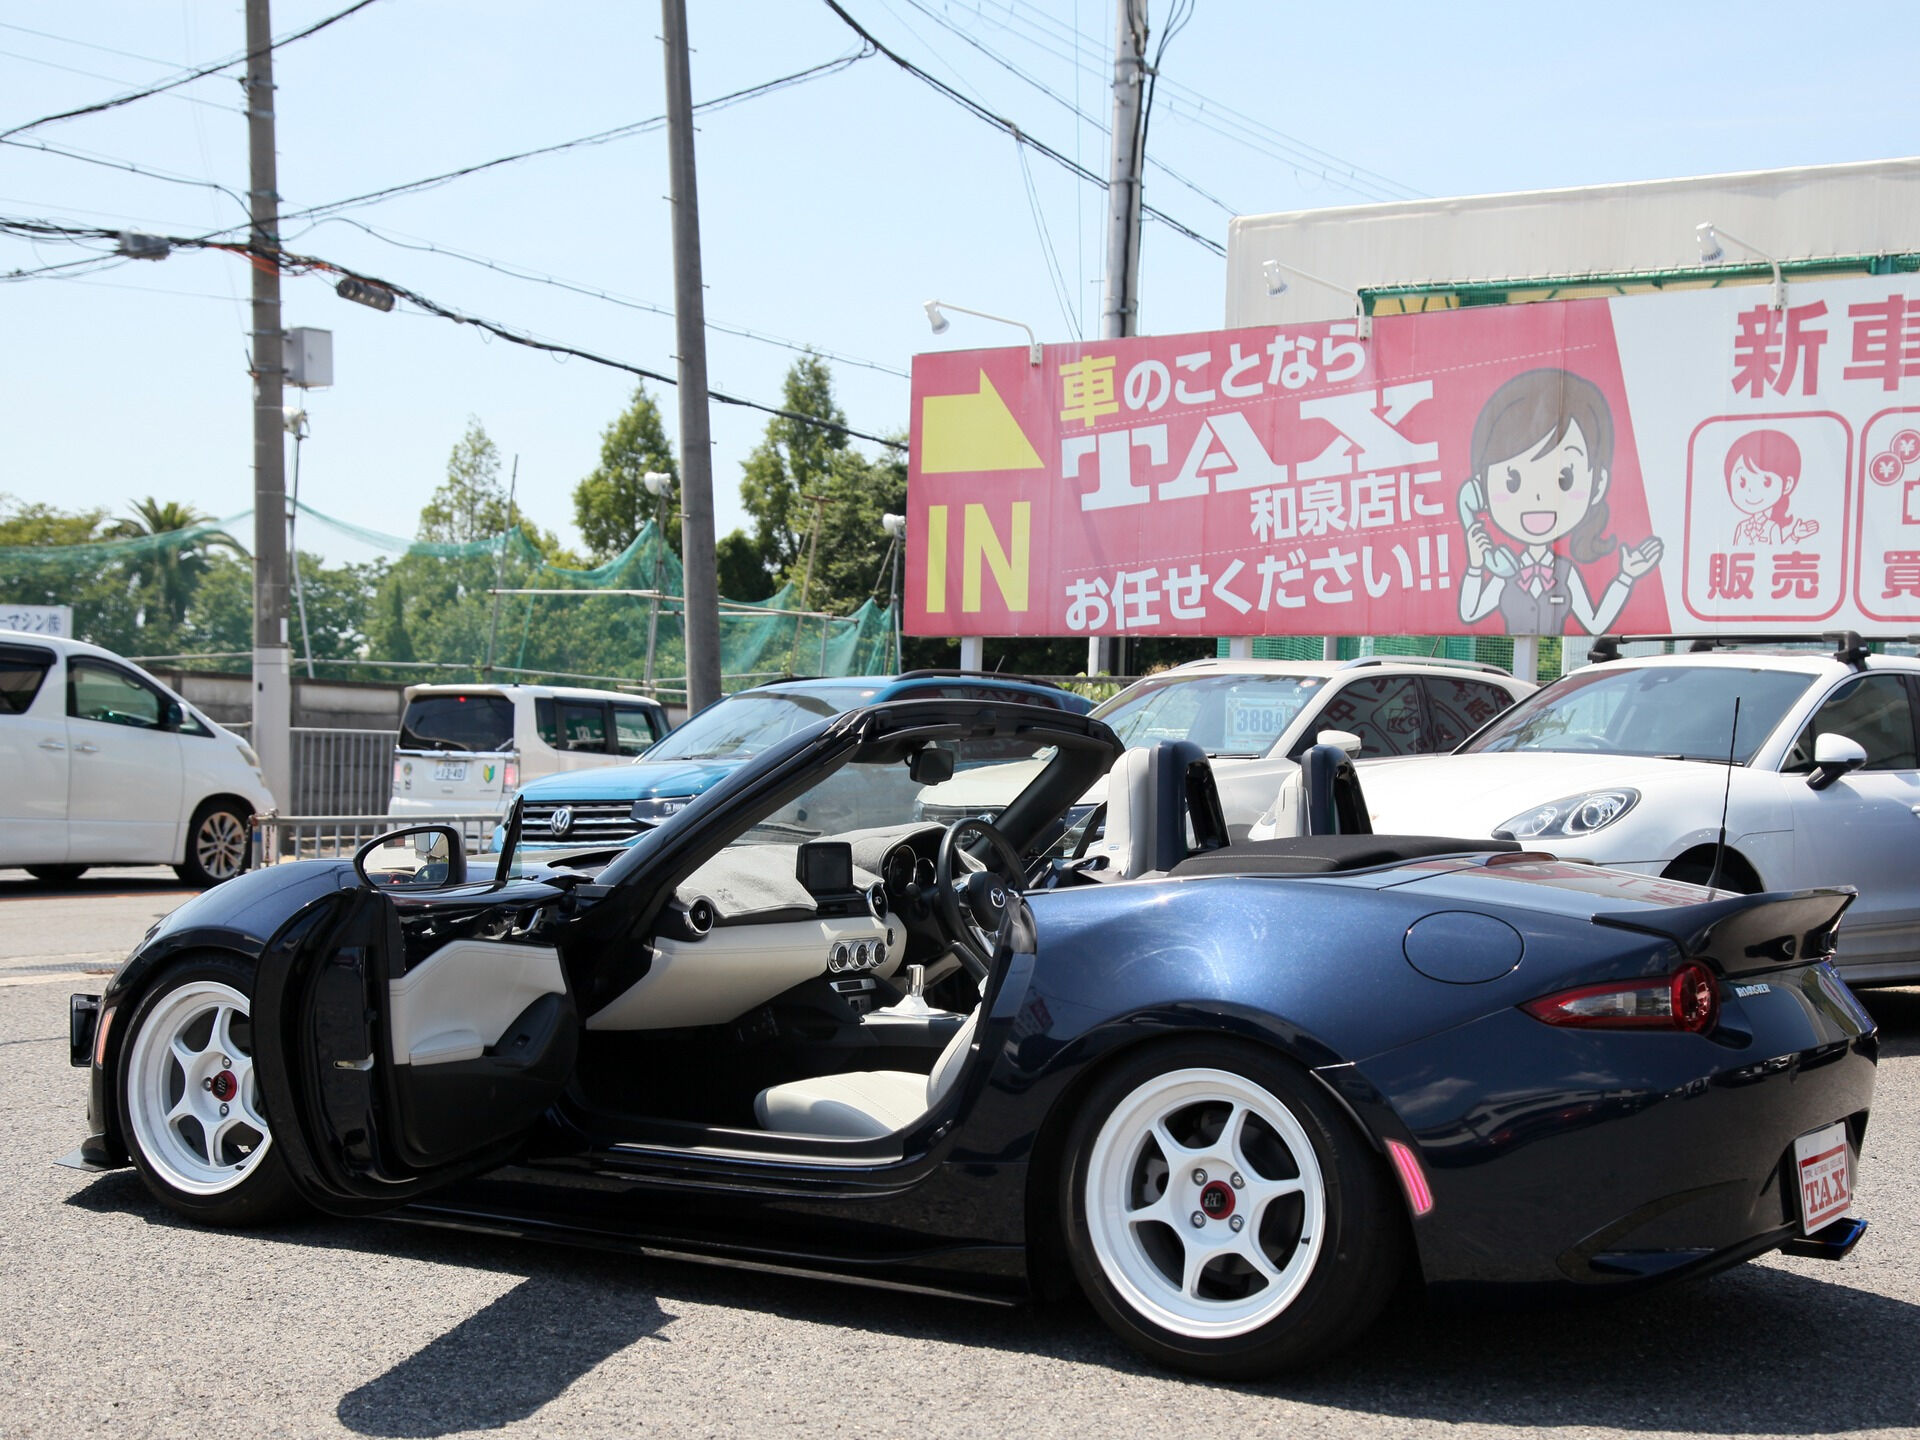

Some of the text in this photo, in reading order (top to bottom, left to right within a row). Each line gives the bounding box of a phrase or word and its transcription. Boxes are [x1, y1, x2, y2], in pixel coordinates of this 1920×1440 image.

[1059, 323, 1366, 427] 車のことなら
[1061, 380, 1439, 511] TAX
[1251, 471, 1444, 542] 和泉店に
[926, 501, 1031, 613] IN
[1708, 551, 1821, 600] 販売
[1805, 1168, 1847, 1214] TAX
